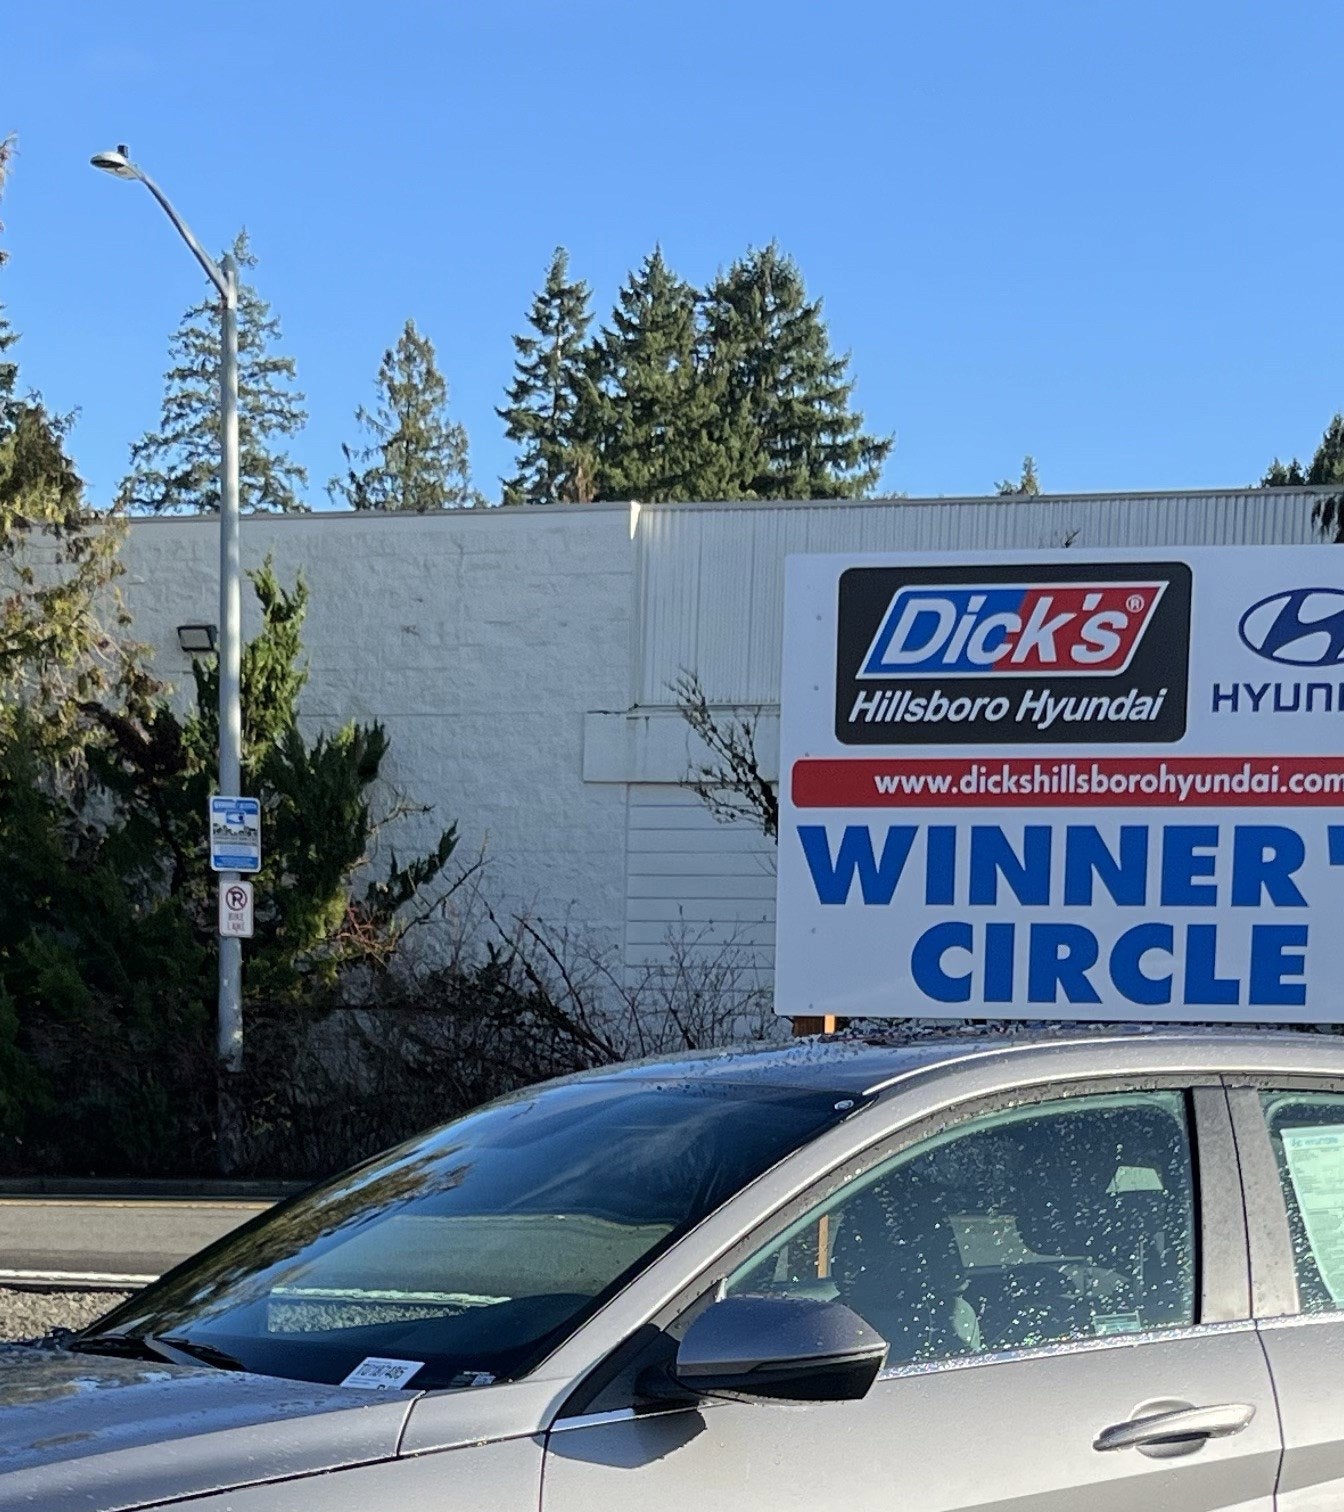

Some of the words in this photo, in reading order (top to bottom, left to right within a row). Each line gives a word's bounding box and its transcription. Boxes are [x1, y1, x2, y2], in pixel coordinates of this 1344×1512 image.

[880, 592, 1129, 666] Dick's
[848, 689, 1010, 723] Hillsboro
[1015, 687, 1169, 730] Hyundai
[910, 920, 1310, 1006] CIRCLE
